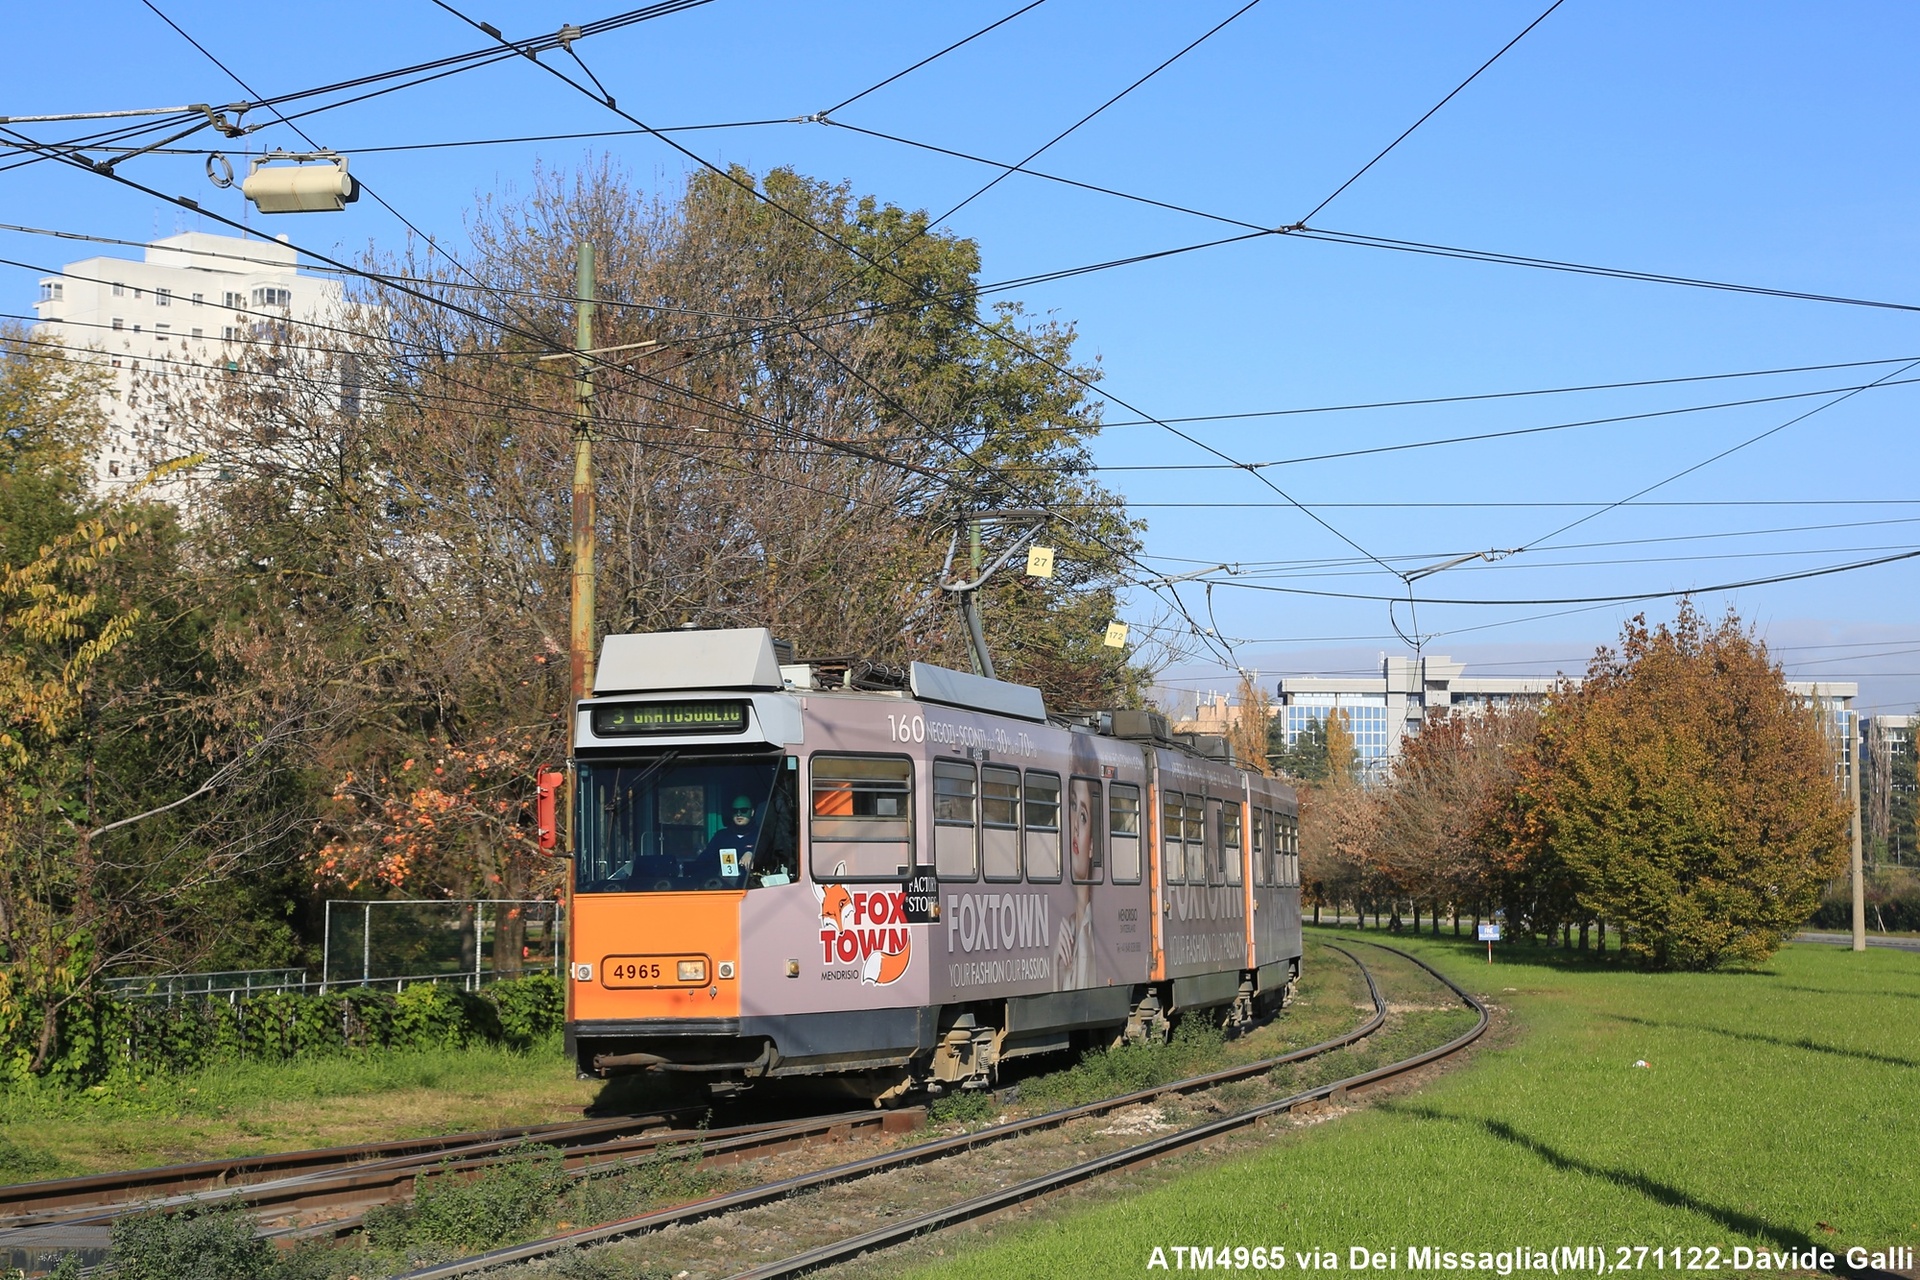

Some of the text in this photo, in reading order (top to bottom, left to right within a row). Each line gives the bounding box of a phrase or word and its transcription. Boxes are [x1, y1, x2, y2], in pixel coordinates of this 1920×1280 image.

[1033, 557, 1047, 567] 27
[1109, 631, 1123, 640] 172
[613, 704, 740, 724] 3 GRATOSOGLIO
[887, 714, 925, 743] 160
[726, 855, 731, 863] 4
[727, 865, 732, 874] 3
[854, 892, 908, 925] FOX
[947, 893, 1049, 952] FOXTOWN
[820, 928, 908, 963] TOWN
[613, 964, 660, 979] 4965
[821, 969, 859, 981] MENDRISIO
[949, 957, 1050, 987] YOUR FASHION OUR PASSION
